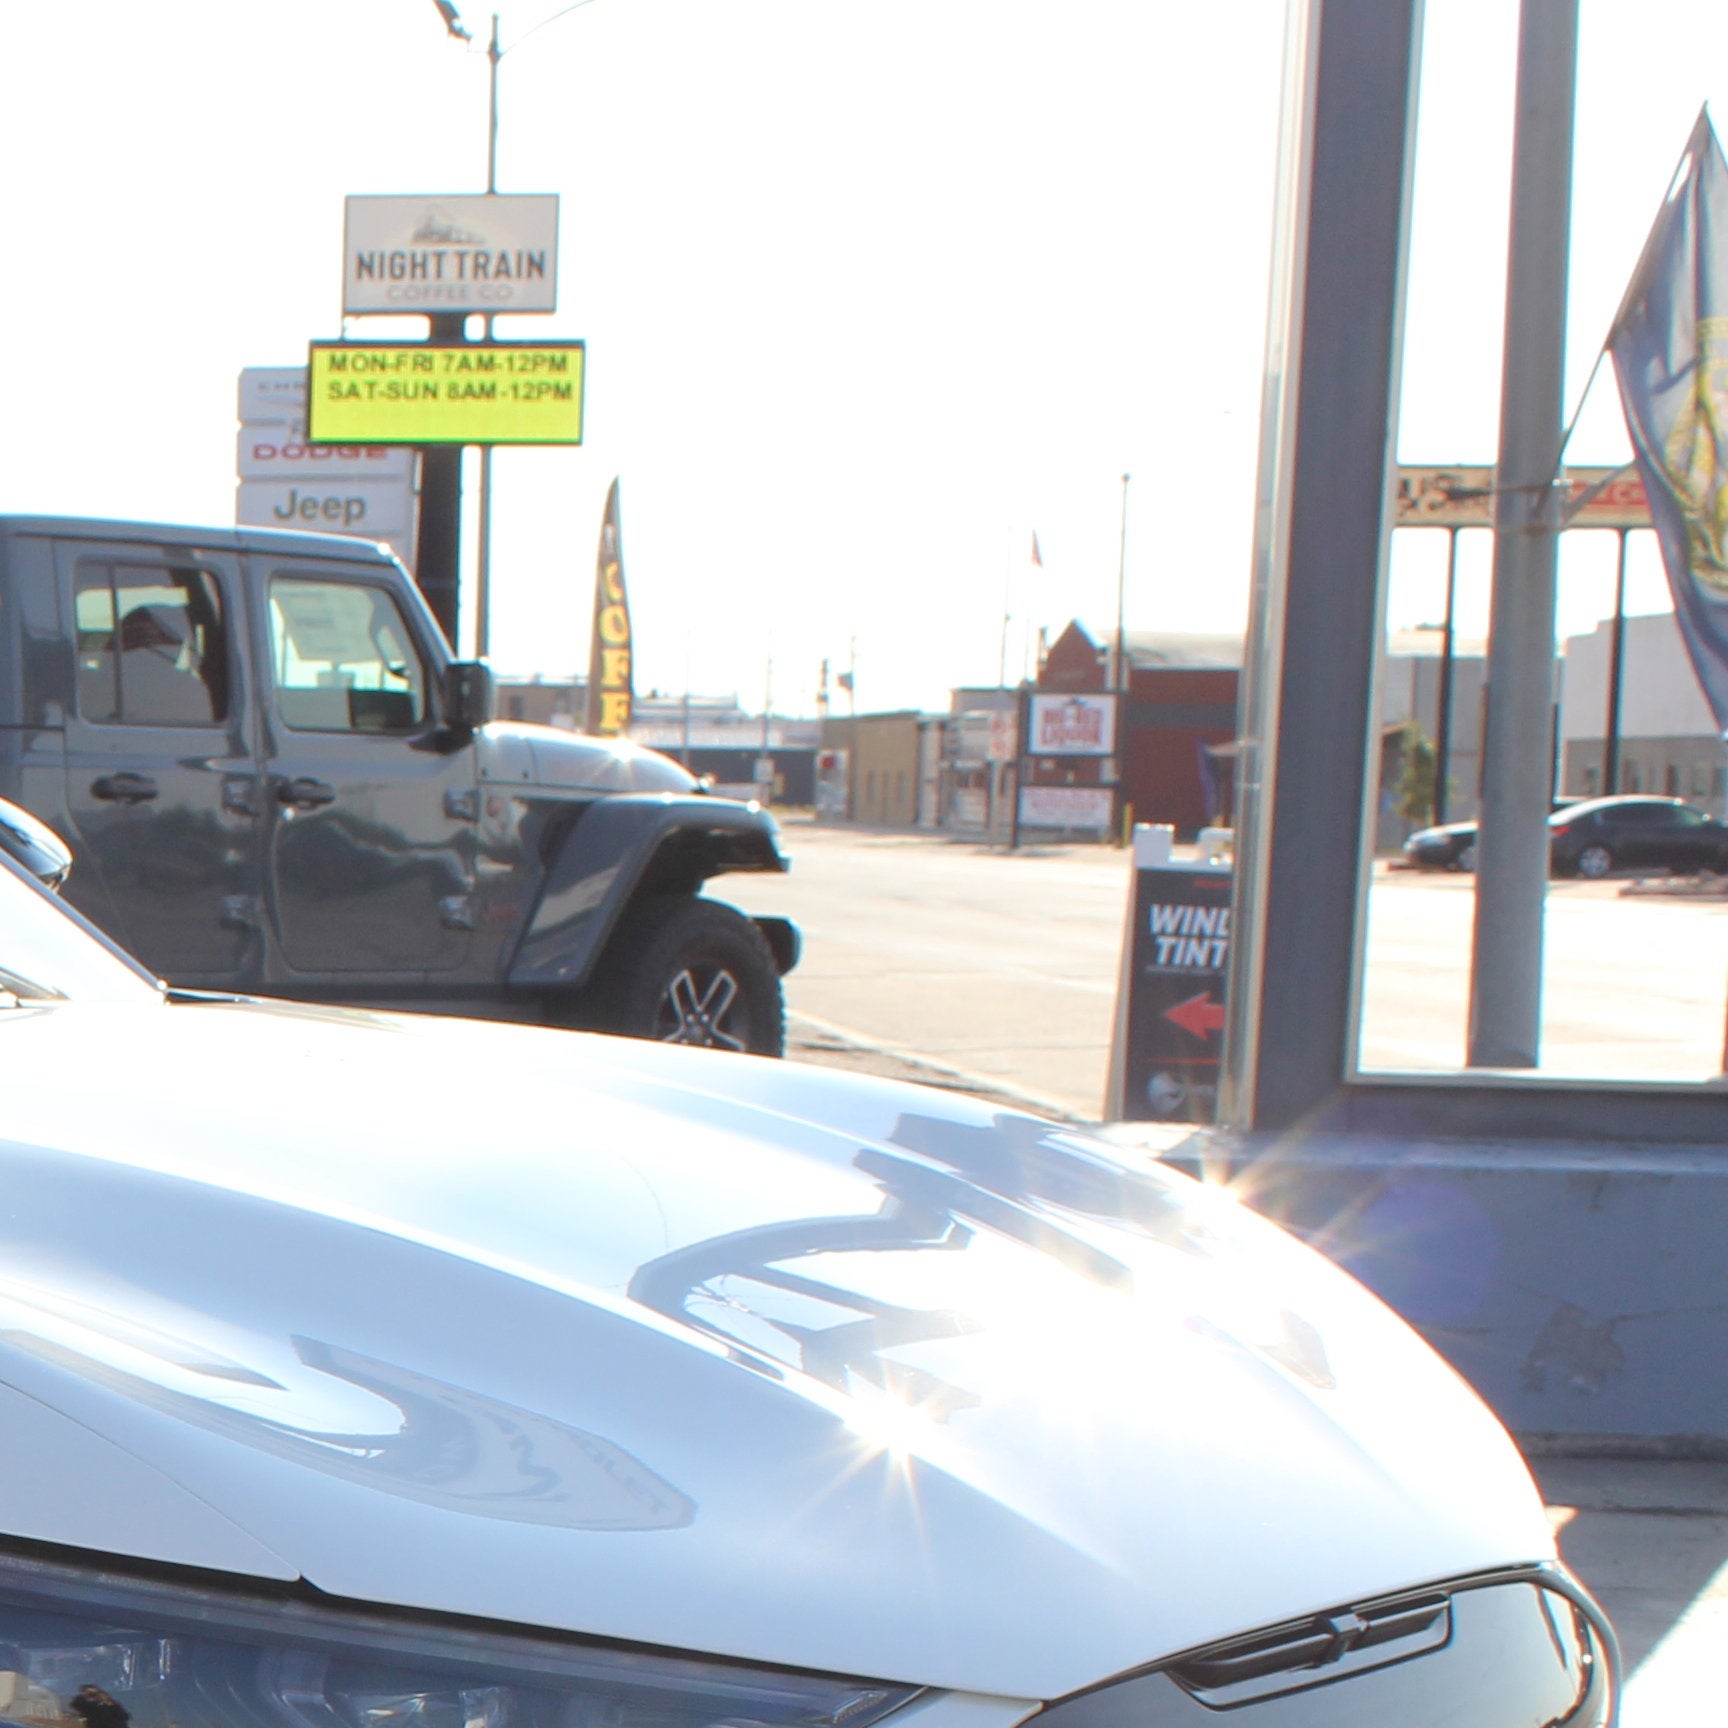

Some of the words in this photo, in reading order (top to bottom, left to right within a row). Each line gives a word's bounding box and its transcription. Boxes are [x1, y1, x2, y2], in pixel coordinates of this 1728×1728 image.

[356, 250, 452, 280] NIGHT
[455, 250, 546, 280] TRAIN
[386, 283, 470, 300] COFFEE
[328, 353, 434, 372] MON-FRI
[444, 353, 568, 373] 7AM-12PM
[328, 380, 439, 400] SAT-SUN
[252, 444, 388, 460] DODGE
[274, 489, 365, 525] Jeep
[1155, 936, 1229, 969] TINT
